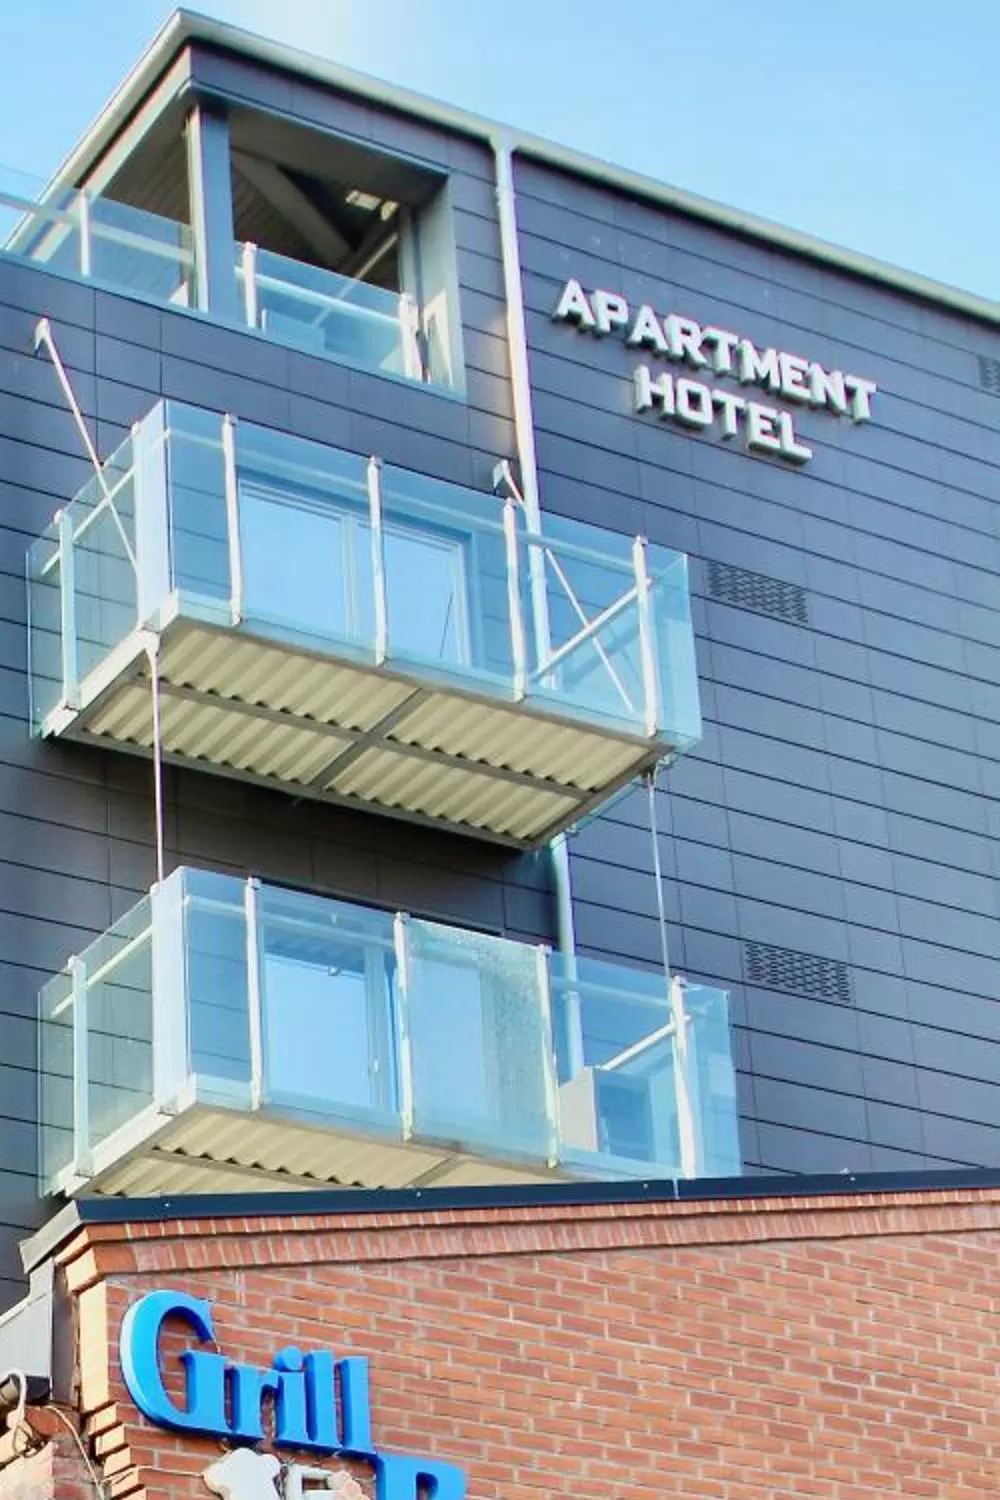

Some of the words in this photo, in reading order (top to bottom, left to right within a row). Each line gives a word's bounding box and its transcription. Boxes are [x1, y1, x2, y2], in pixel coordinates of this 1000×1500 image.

[552, 279, 877, 424] APARTMENT
[632, 365, 813, 465] HOTEL
[118, 1289, 376, 1456] Grill
